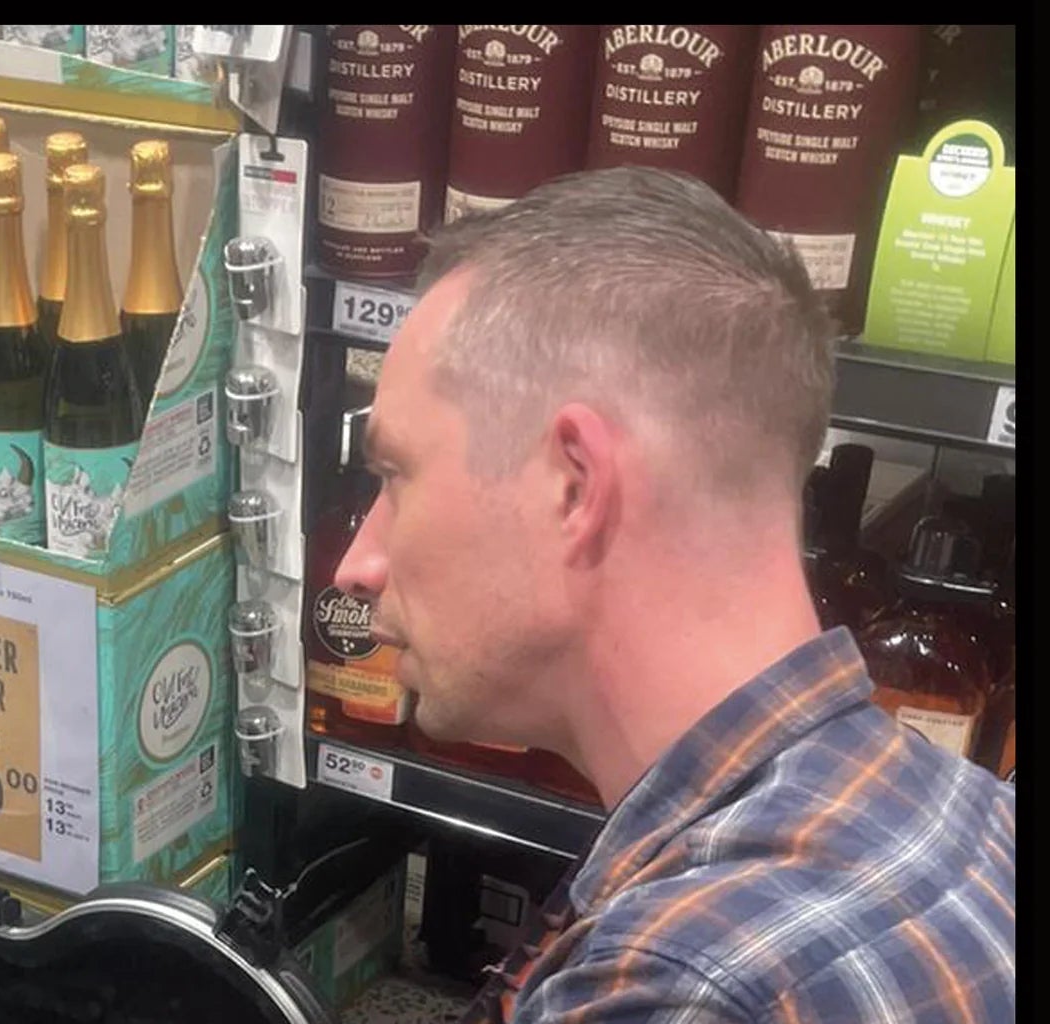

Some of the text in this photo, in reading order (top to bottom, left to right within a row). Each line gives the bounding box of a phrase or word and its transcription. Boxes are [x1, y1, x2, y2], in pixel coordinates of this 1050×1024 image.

[604, 25, 720, 68] ABERLOUR
[762, 33, 884, 82] ABERLOUR
[329, 58, 415, 79] DISTILLERY
[458, 68, 542, 92] DISTILLERY
[605, 83, 701, 106] DISTILLERY
[762, 96, 863, 120] DISTILLERY
[317, 597, 371, 626] Smok
